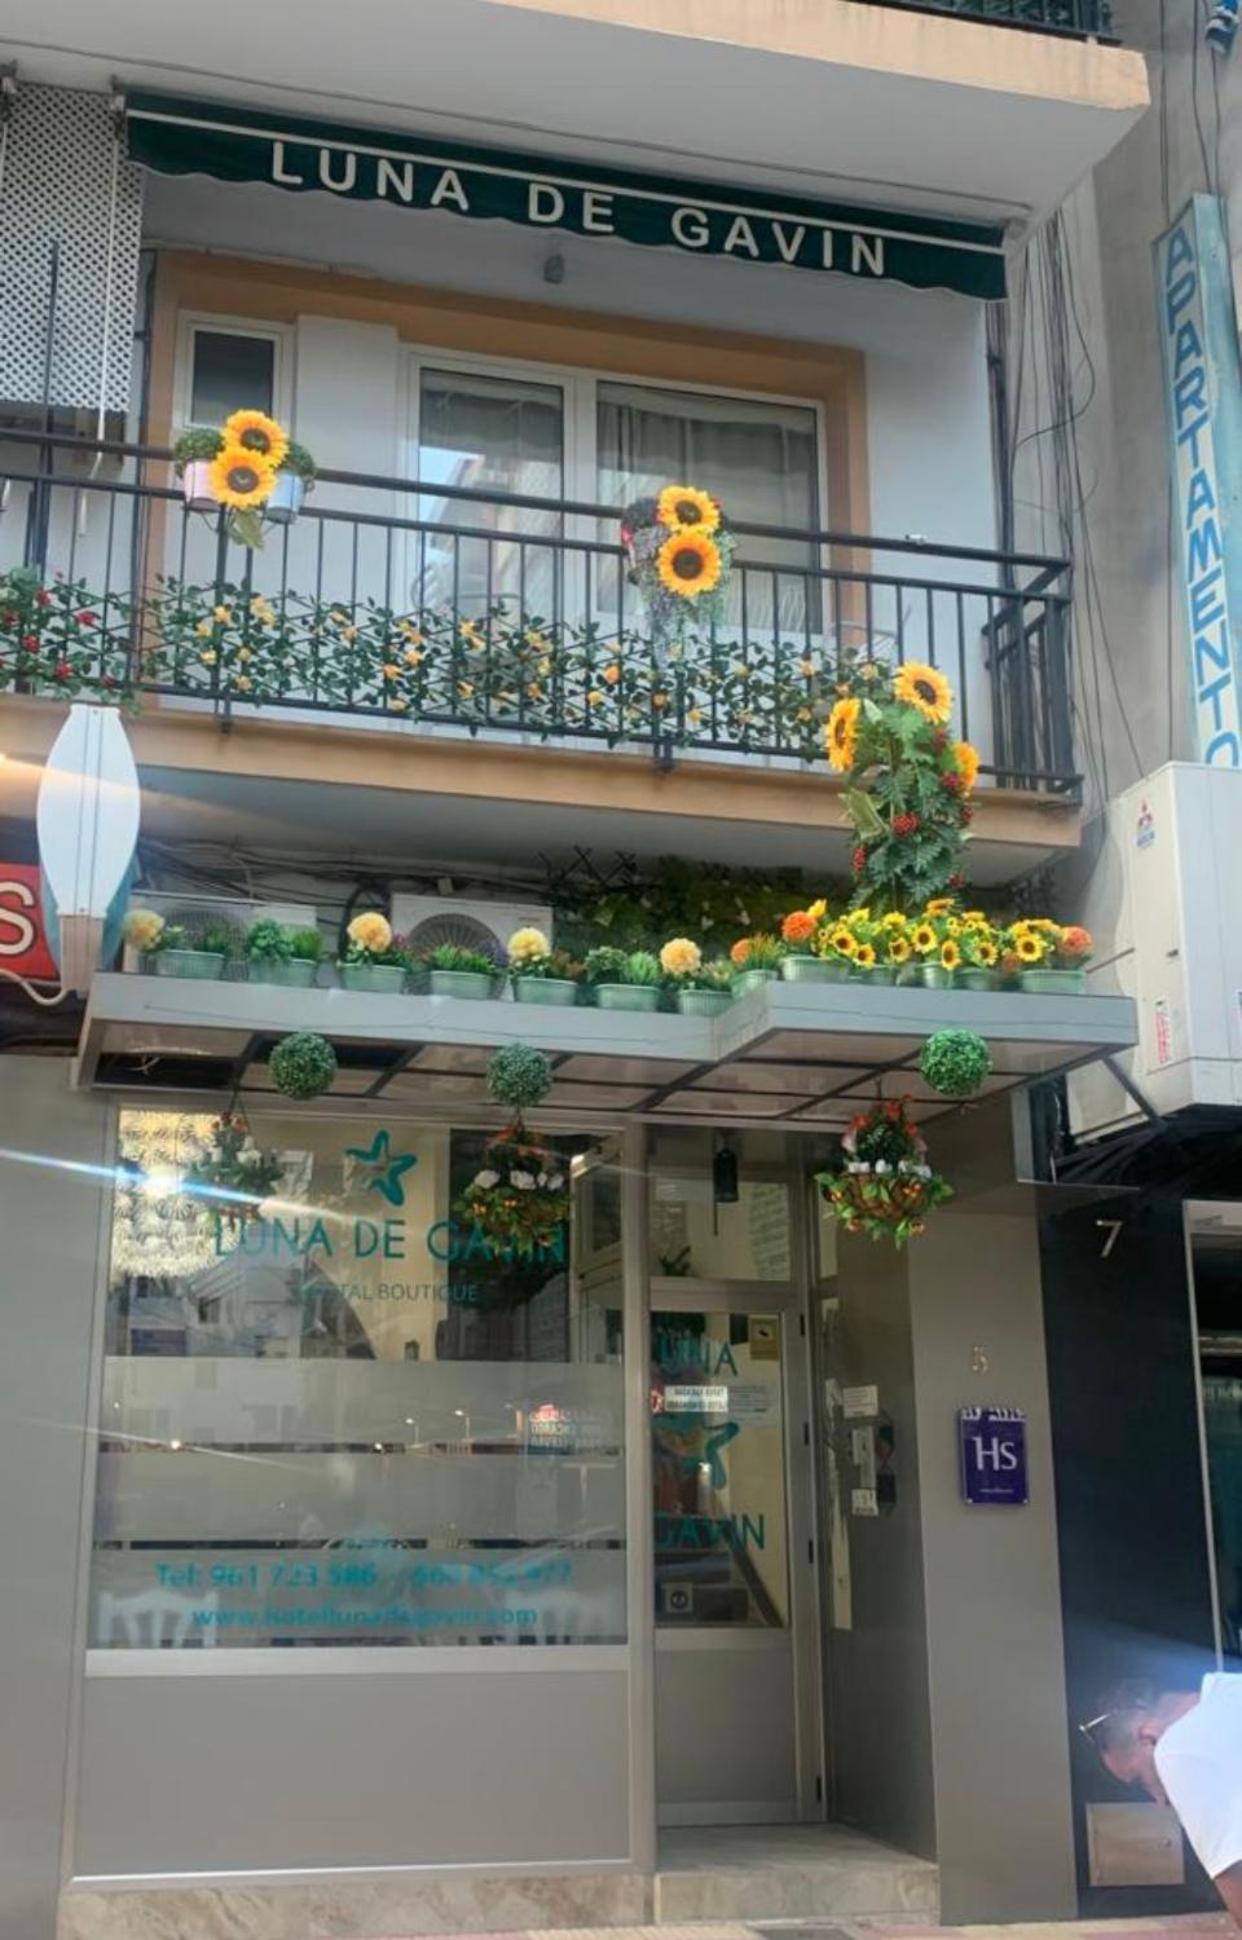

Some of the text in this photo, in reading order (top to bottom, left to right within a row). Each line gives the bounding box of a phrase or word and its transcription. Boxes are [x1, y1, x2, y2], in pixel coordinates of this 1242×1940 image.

[272, 141, 884, 276] LUNA DE GAVIN
[214, 1216, 569, 1264] LUNA DE GAN
[1096, 1219, 1123, 1258] 7
[377, 1282, 481, 1303] BOUTIQUE
